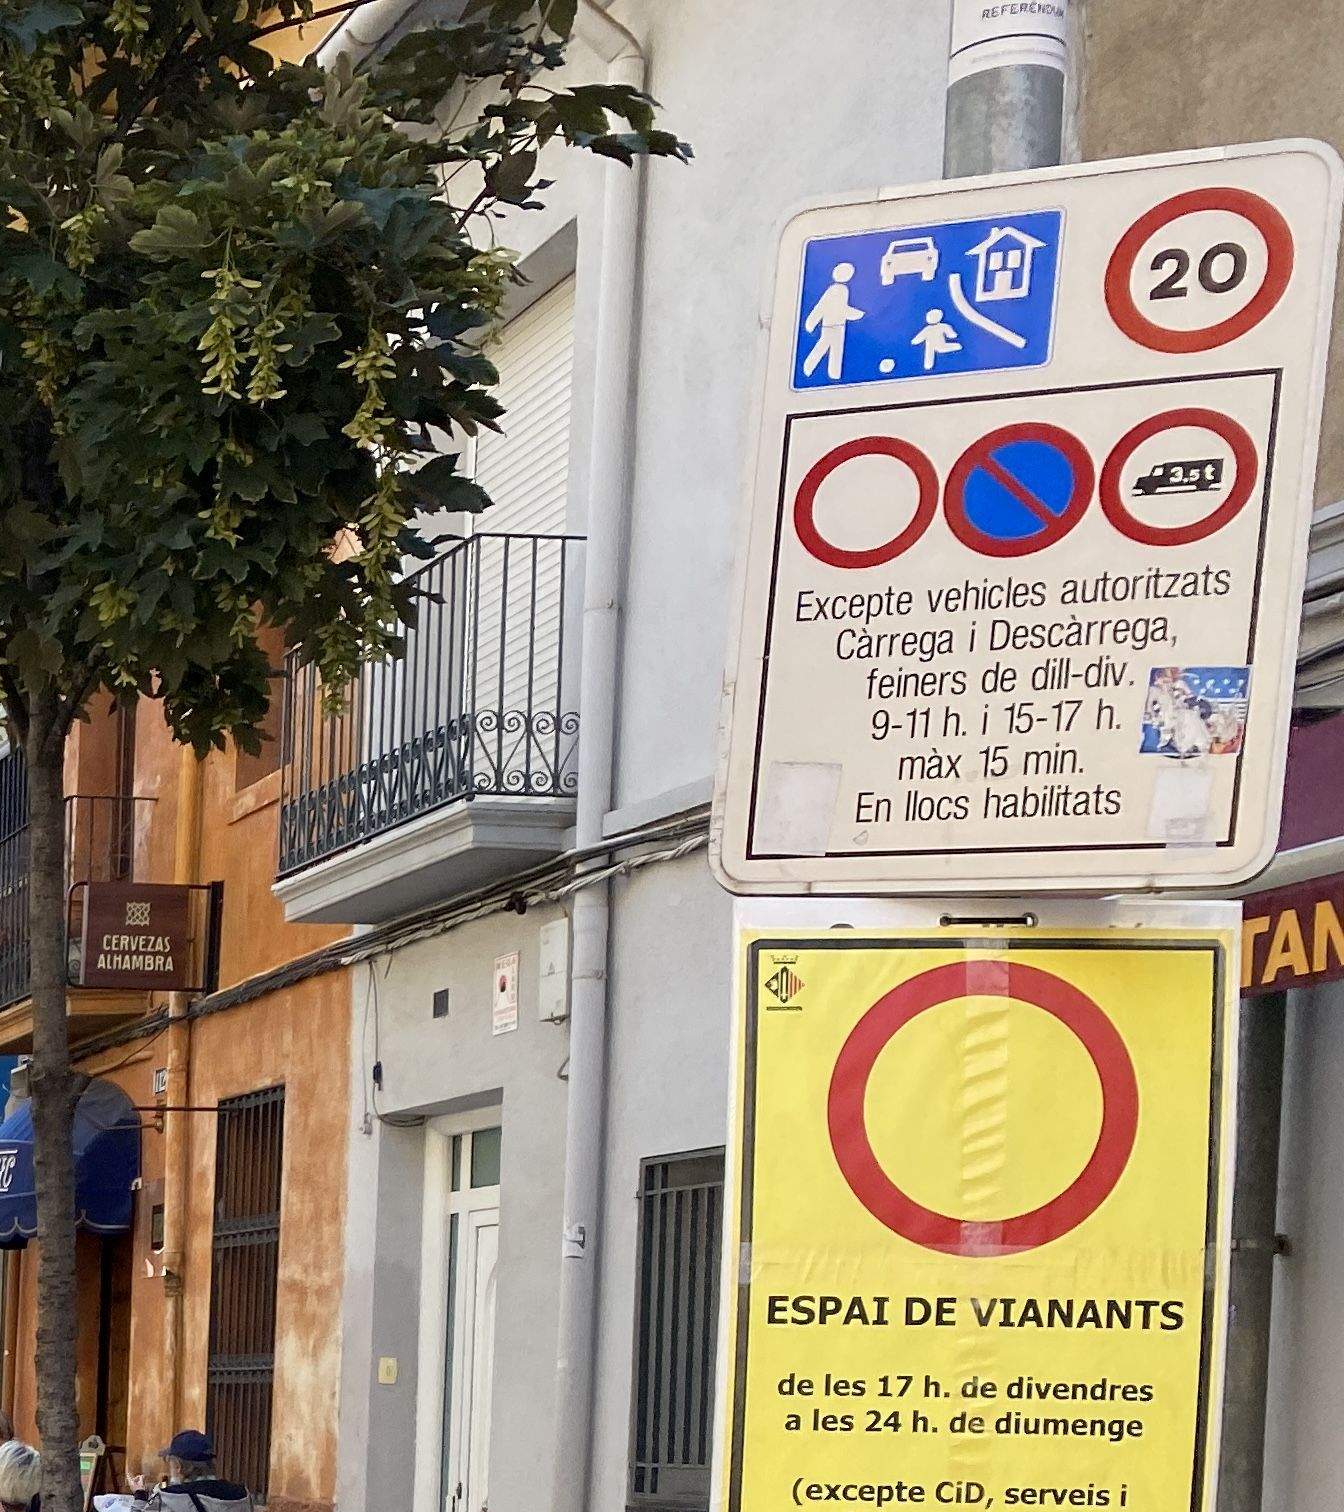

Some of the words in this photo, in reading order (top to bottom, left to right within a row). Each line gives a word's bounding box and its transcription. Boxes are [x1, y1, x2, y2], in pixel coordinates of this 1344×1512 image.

[1150, 243, 1248, 300] 20
[1204, 463, 1216, 481] t
[796, 586, 912, 623] Excepte
[928, 577, 1046, 612] vehicles
[1061, 564, 1230, 604] autoritzats
[837, 620, 953, 659] Càrrega
[970, 621, 976, 652] i
[990, 615, 1177, 651] Descàrrega,
[867, 667, 966, 699] feiners
[982, 662, 1016, 693] de
[1033, 658, 1135, 690] dill-div.
[872, 707, 930, 740] 9-11
[943, 706, 966, 736] h.
[982, 704, 988, 735] i
[1005, 700, 1083, 733] 15-17
[1096, 698, 1120, 729] h.
[899, 748, 961, 780] màx
[980, 746, 1008, 777] 15
[1023, 743, 1083, 775] min.
[856, 792, 891, 823] En
[906, 791, 969, 821] llocs
[984, 784, 1121, 818] habilitats
[103, 935, 171, 952] CERVEZAS
[97, 954, 173, 971] ALHAMBRA
[768, 1296, 889, 1325] ESPAI
[905, 1297, 957, 1326] DE
[971, 1298, 1183, 1328] VIANANTS
[778, 1373, 813, 1395] de
[825, 1374, 866, 1396] les
[878, 1376, 913, 1397] 17
[924, 1375, 949, 1397] h.
[962, 1376, 997, 1398] de
[1007, 1377, 1153, 1401] divendres
[785, 1414, 800, 1430] a
[813, 1409, 853, 1431] les
[865, 1410, 901, 1432] 24
[913, 1410, 937, 1432] h.
[950, 1412, 984, 1433] de
[995, 1412, 1142, 1442] diumenge
[793, 1478, 925, 1507] (excepte
[936, 1481, 993, 1509] CiD,
[1005, 1484, 1109, 1506] serveis
[1121, 1484, 1126, 1506] i
